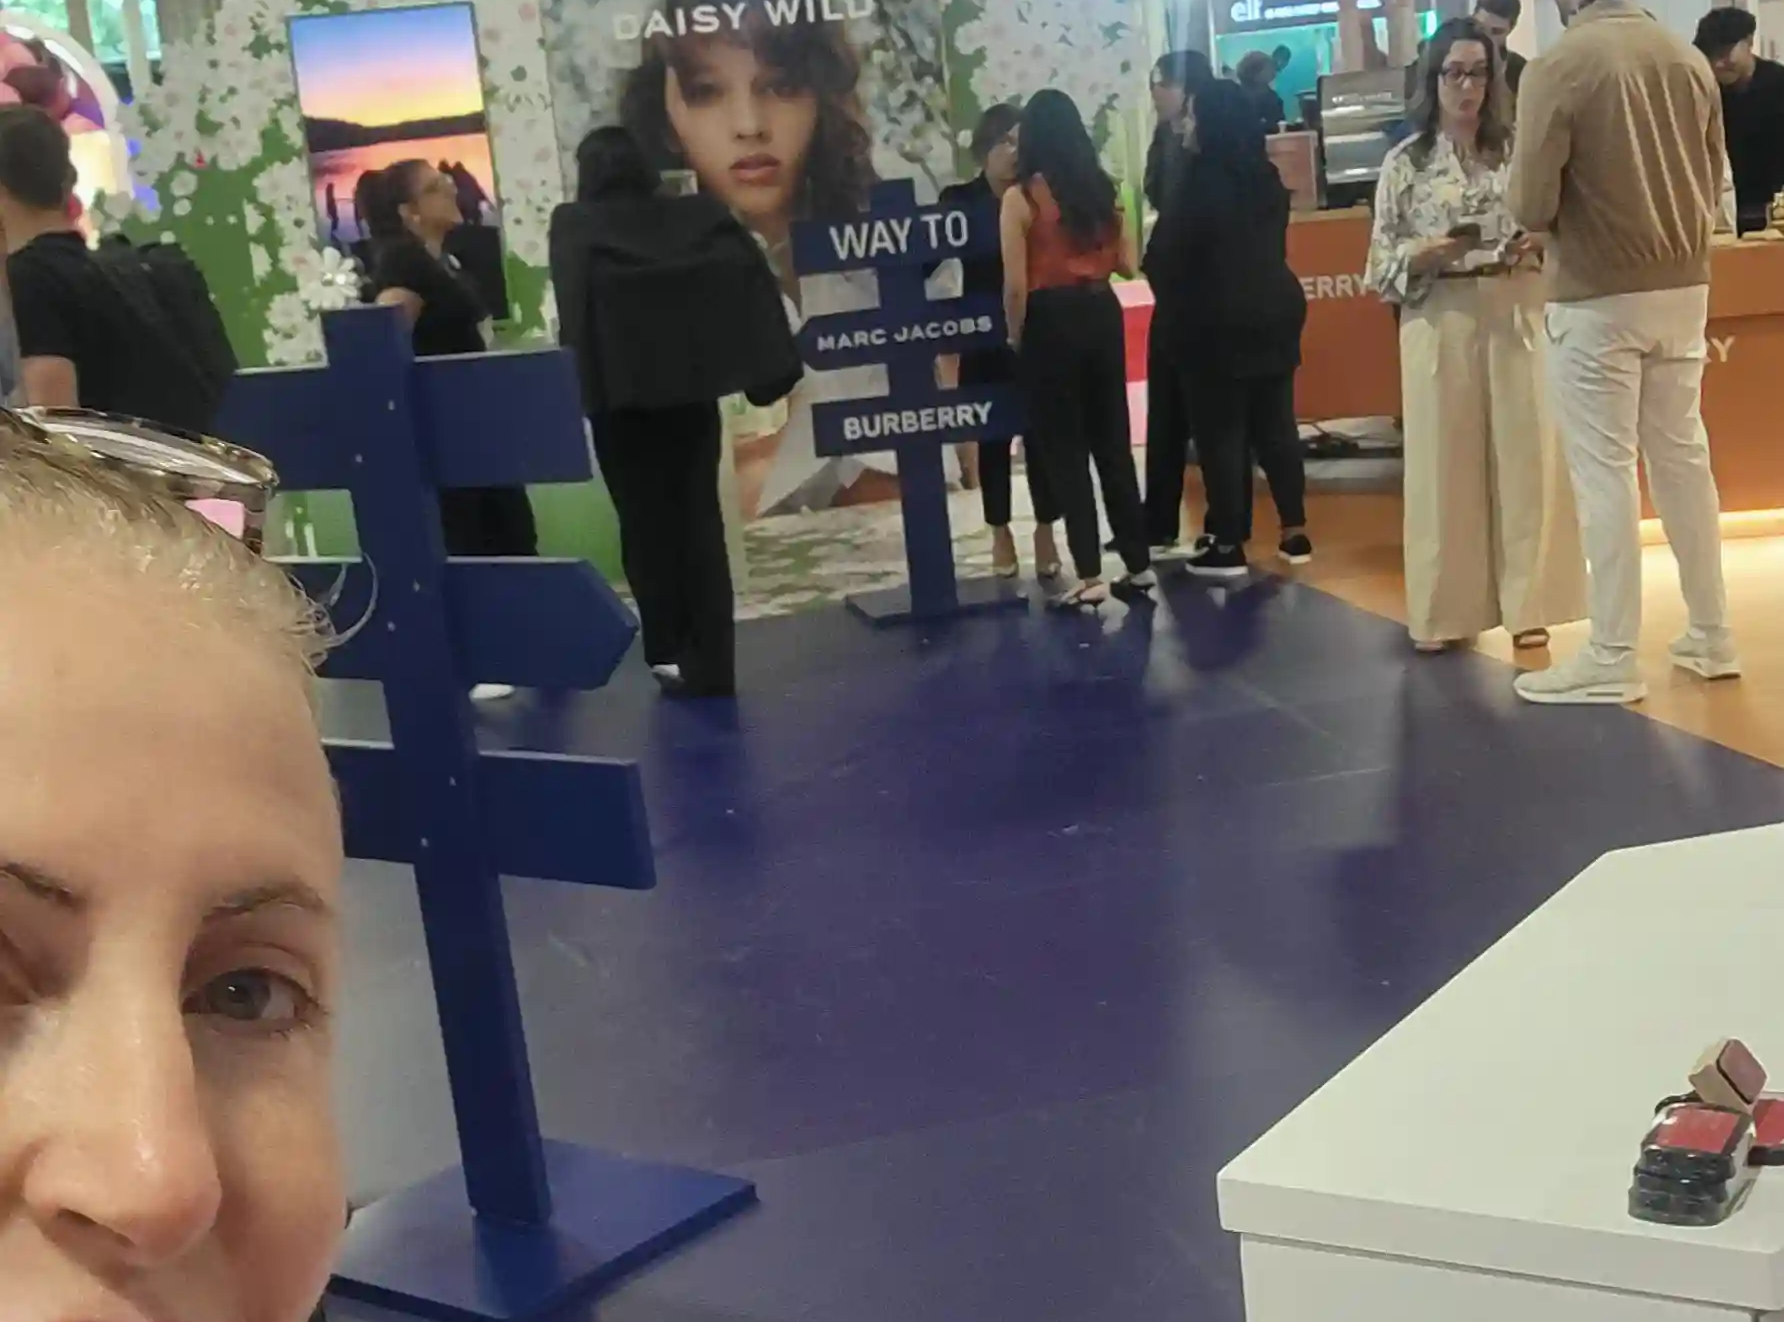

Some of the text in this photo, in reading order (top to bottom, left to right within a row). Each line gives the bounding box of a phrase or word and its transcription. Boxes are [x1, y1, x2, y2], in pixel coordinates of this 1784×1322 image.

[613, 3, 746, 41] DAISY
[829, 211, 969, 261] WAY TO
[817, 315, 993, 351] MARC JACOBS
[843, 401, 993, 440] BURBERRY
